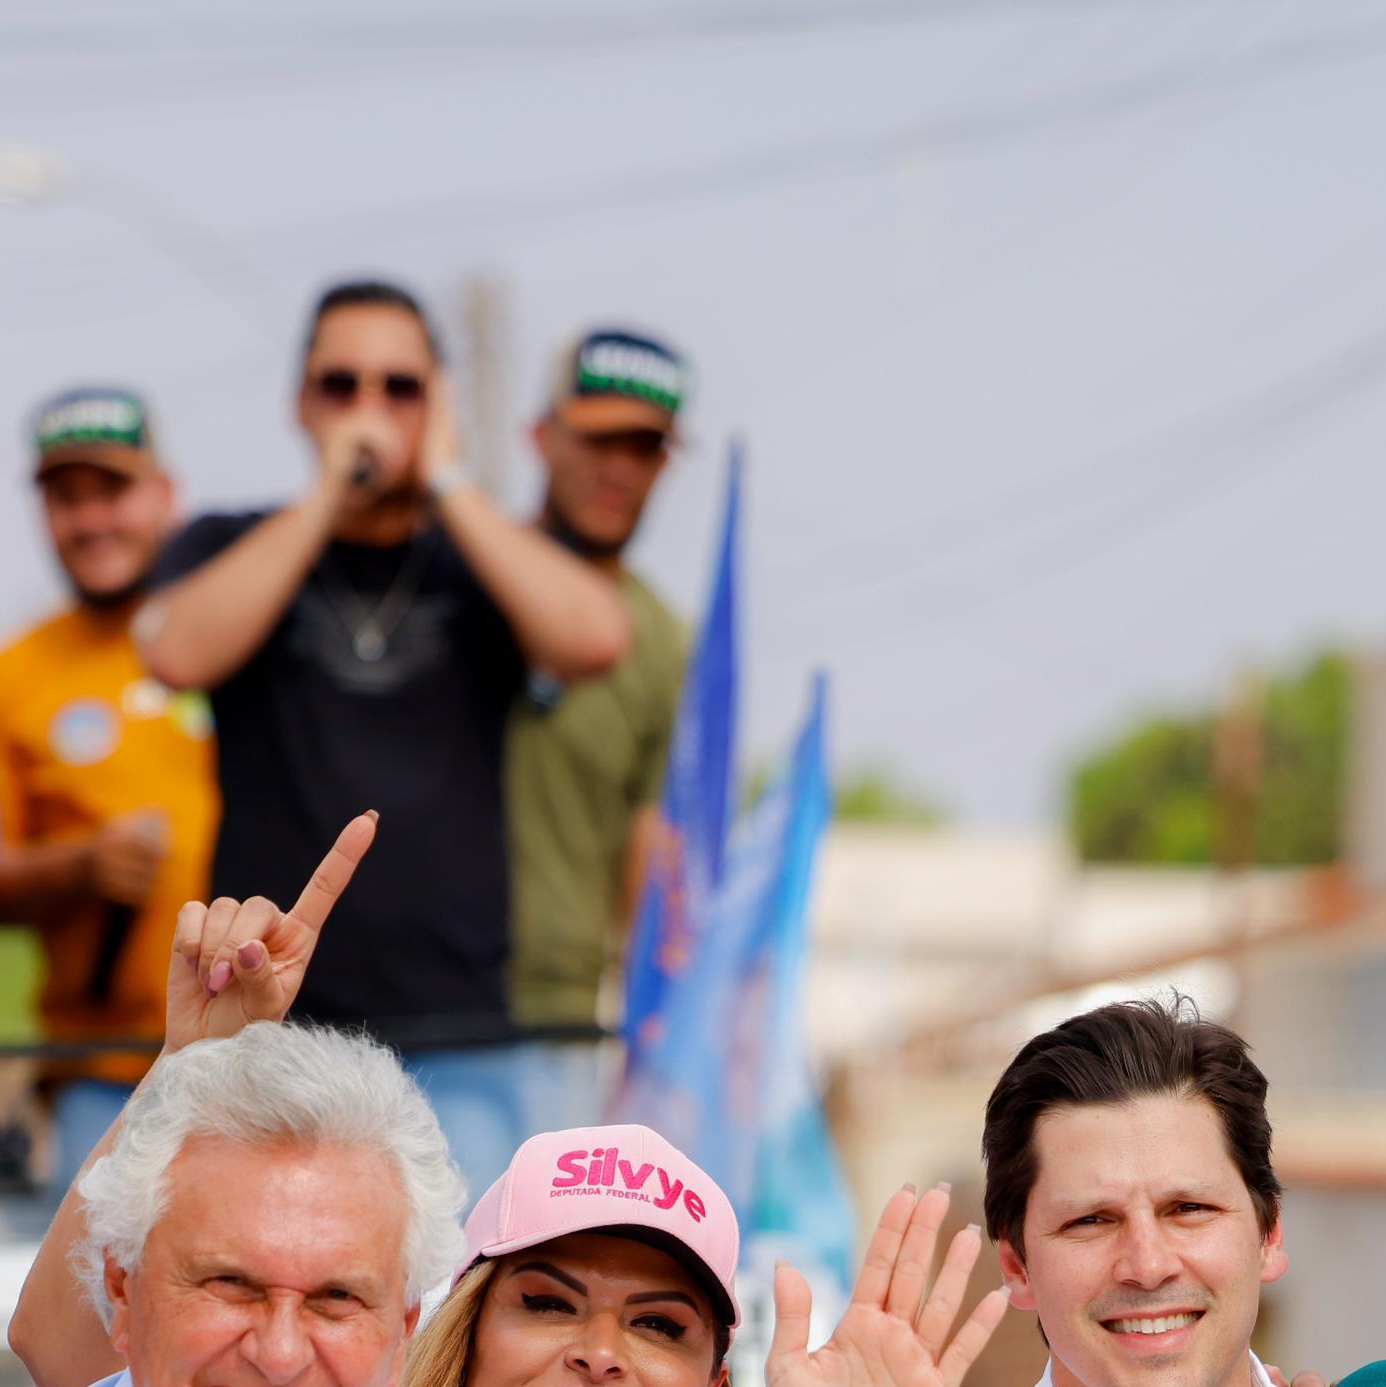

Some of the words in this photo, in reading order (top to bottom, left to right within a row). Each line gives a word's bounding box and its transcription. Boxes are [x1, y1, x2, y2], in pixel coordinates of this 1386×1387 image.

[550, 1188, 601, 1198] DEPUTADA
[606, 1188, 652, 1203] FEDERAL
[552, 1147, 706, 1223] Silvye
